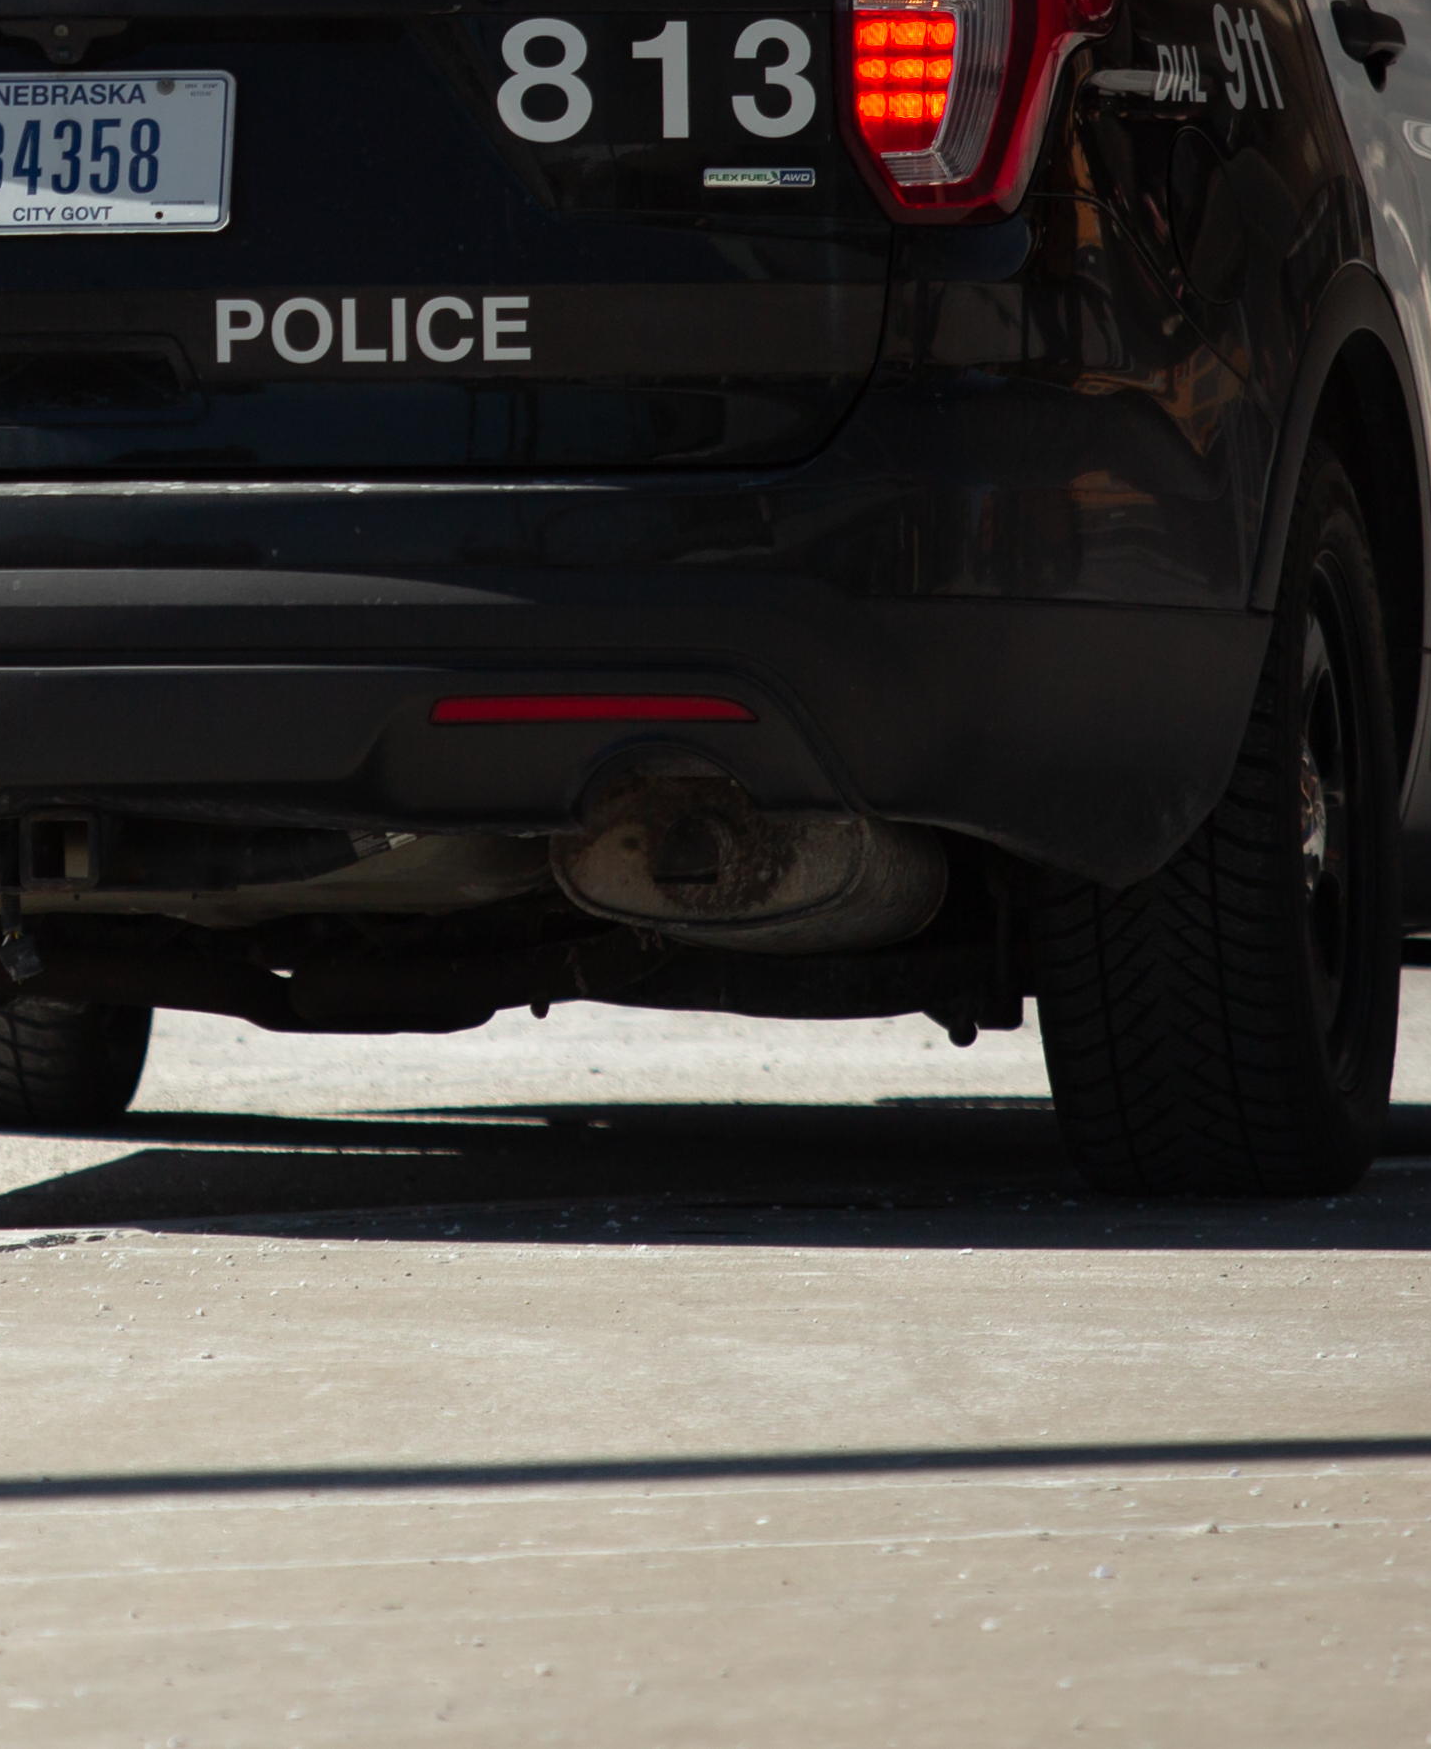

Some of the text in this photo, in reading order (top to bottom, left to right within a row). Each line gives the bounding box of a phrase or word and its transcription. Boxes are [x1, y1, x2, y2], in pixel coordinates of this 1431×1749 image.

[496, 17, 817, 144] 813
[1154, 3, 1285, 110] DIAL 911
[708, 173, 811, 182] FLEX FUEL AWD
[12, 206, 113, 222] CITY GOVT
[215, 296, 532, 364] POLICE
